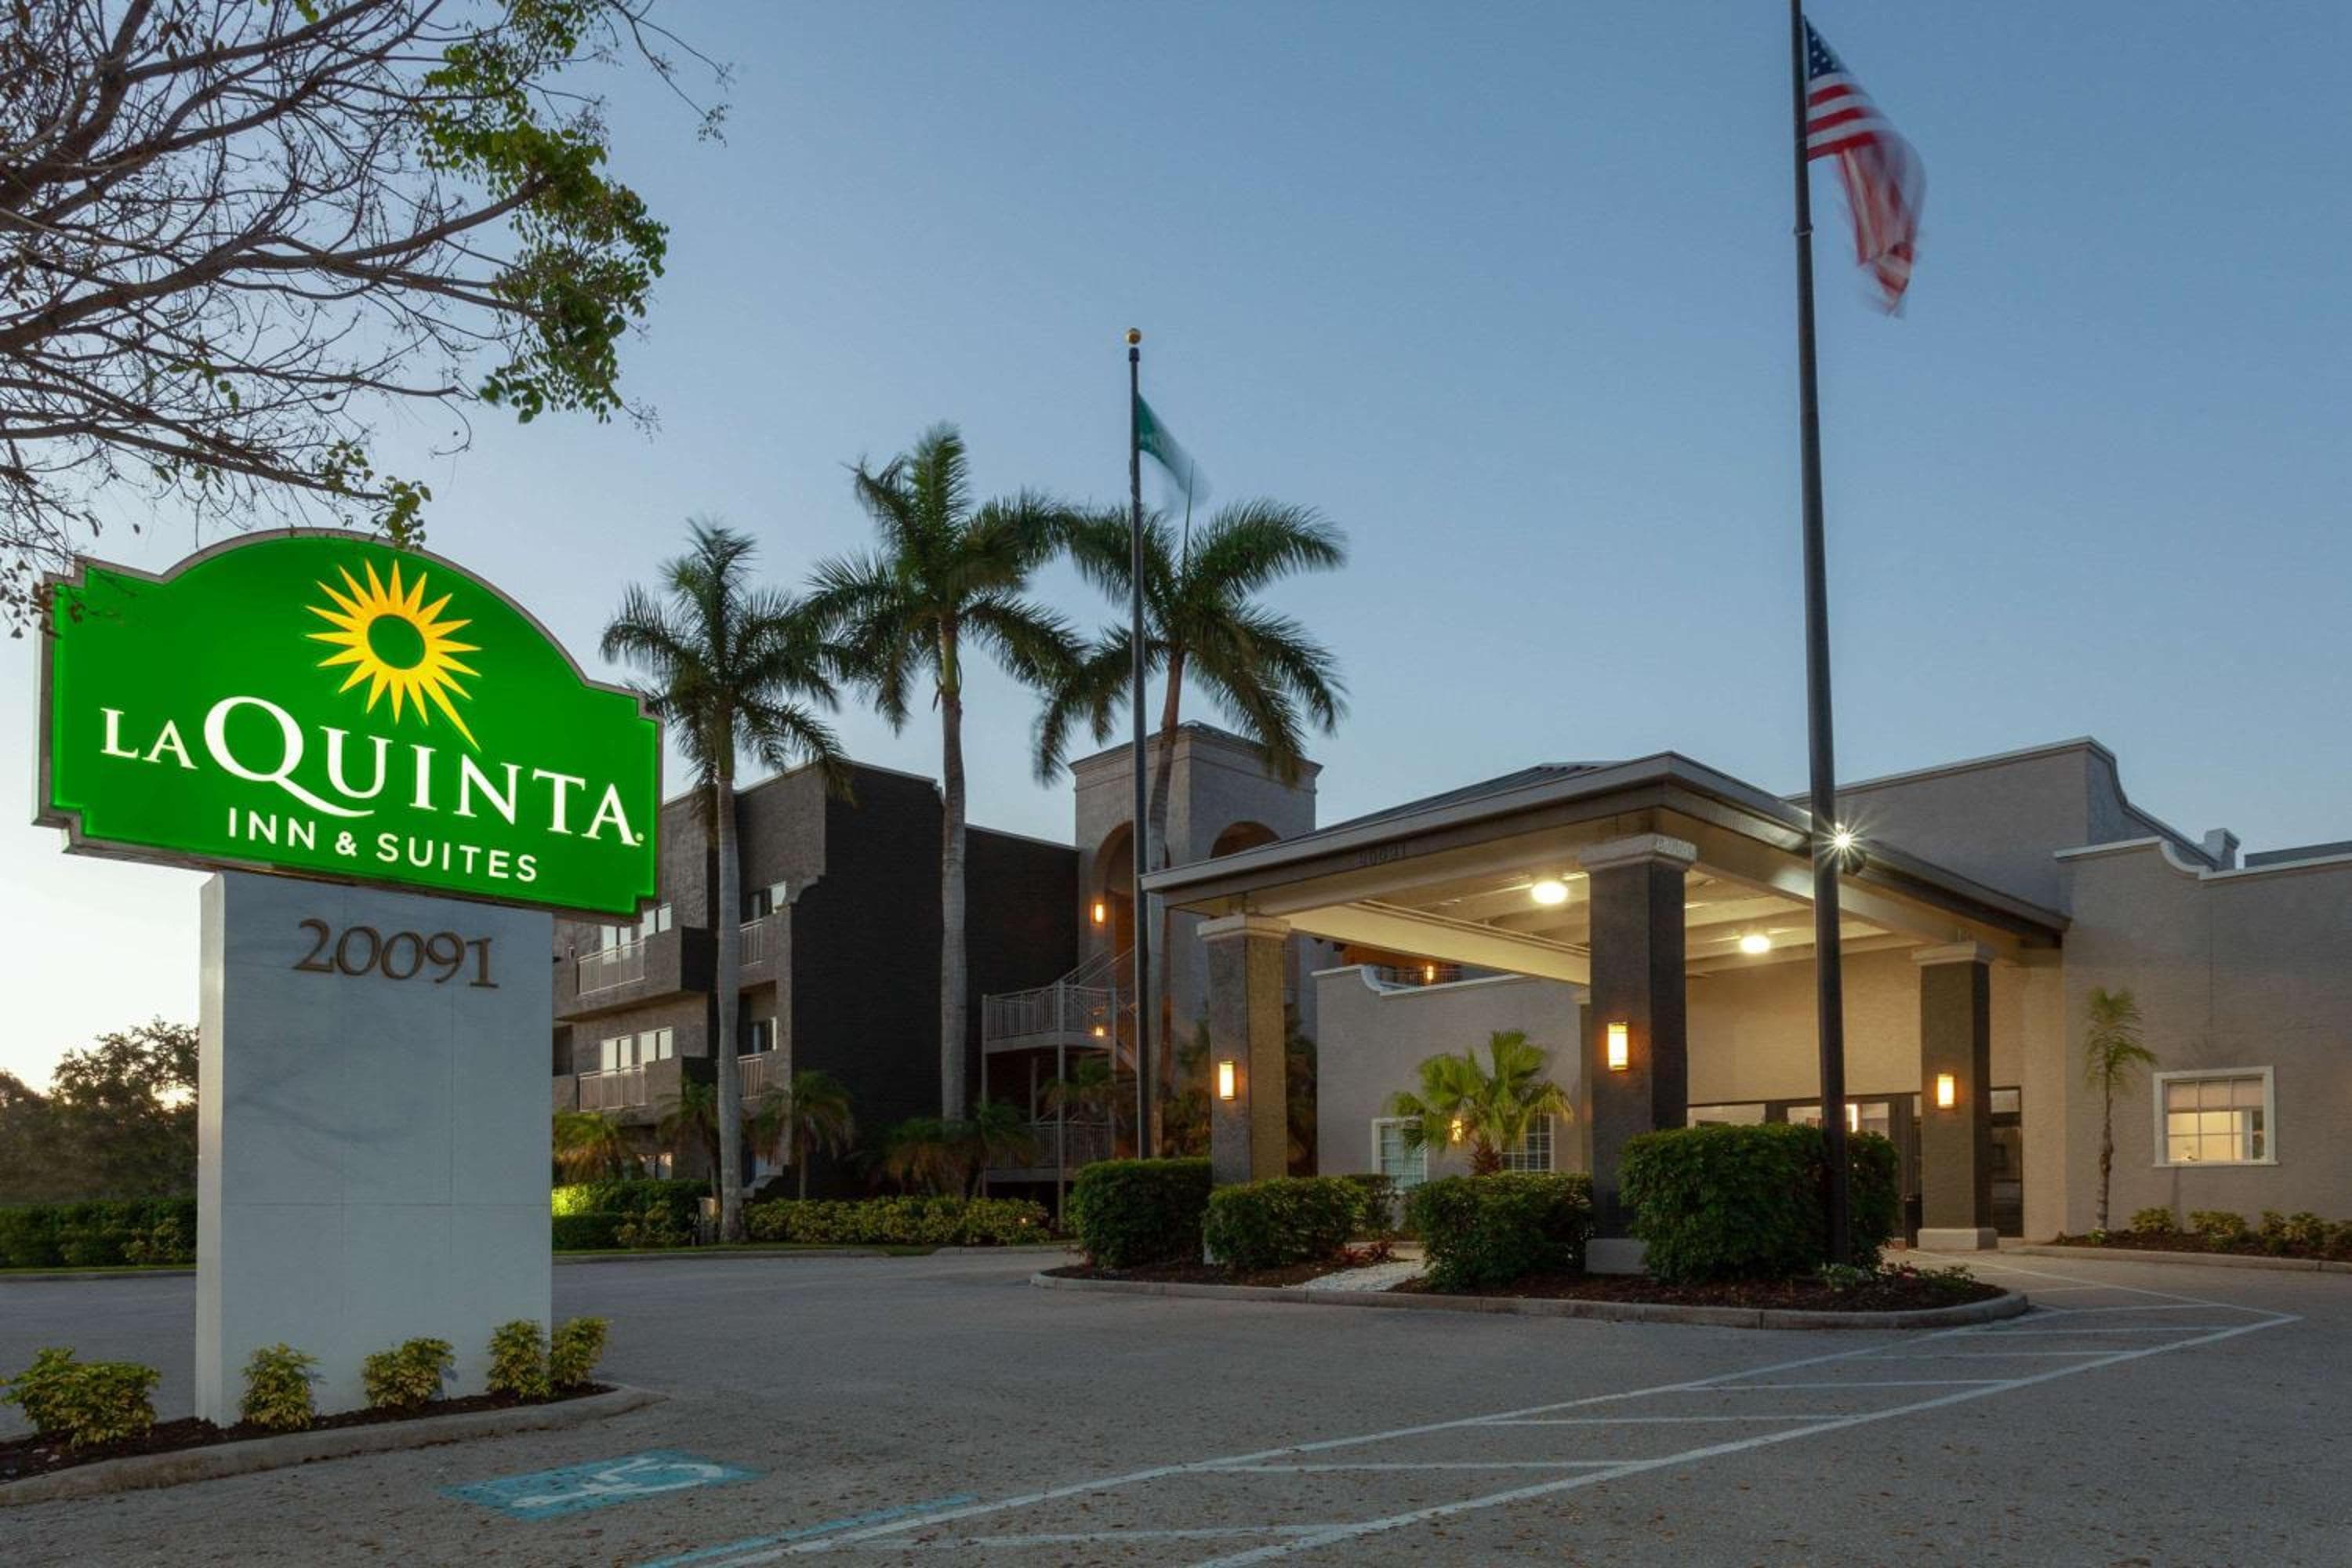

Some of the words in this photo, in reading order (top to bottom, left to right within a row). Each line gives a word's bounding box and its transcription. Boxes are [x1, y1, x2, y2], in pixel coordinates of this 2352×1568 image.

[100, 707, 198, 770] LA
[202, 695, 641, 847] QUINTA
[227, 806, 316, 851] INN
[335, 830, 358, 857] &
[375, 833, 538, 883] SUITES
[292, 918, 499, 988] 20091
